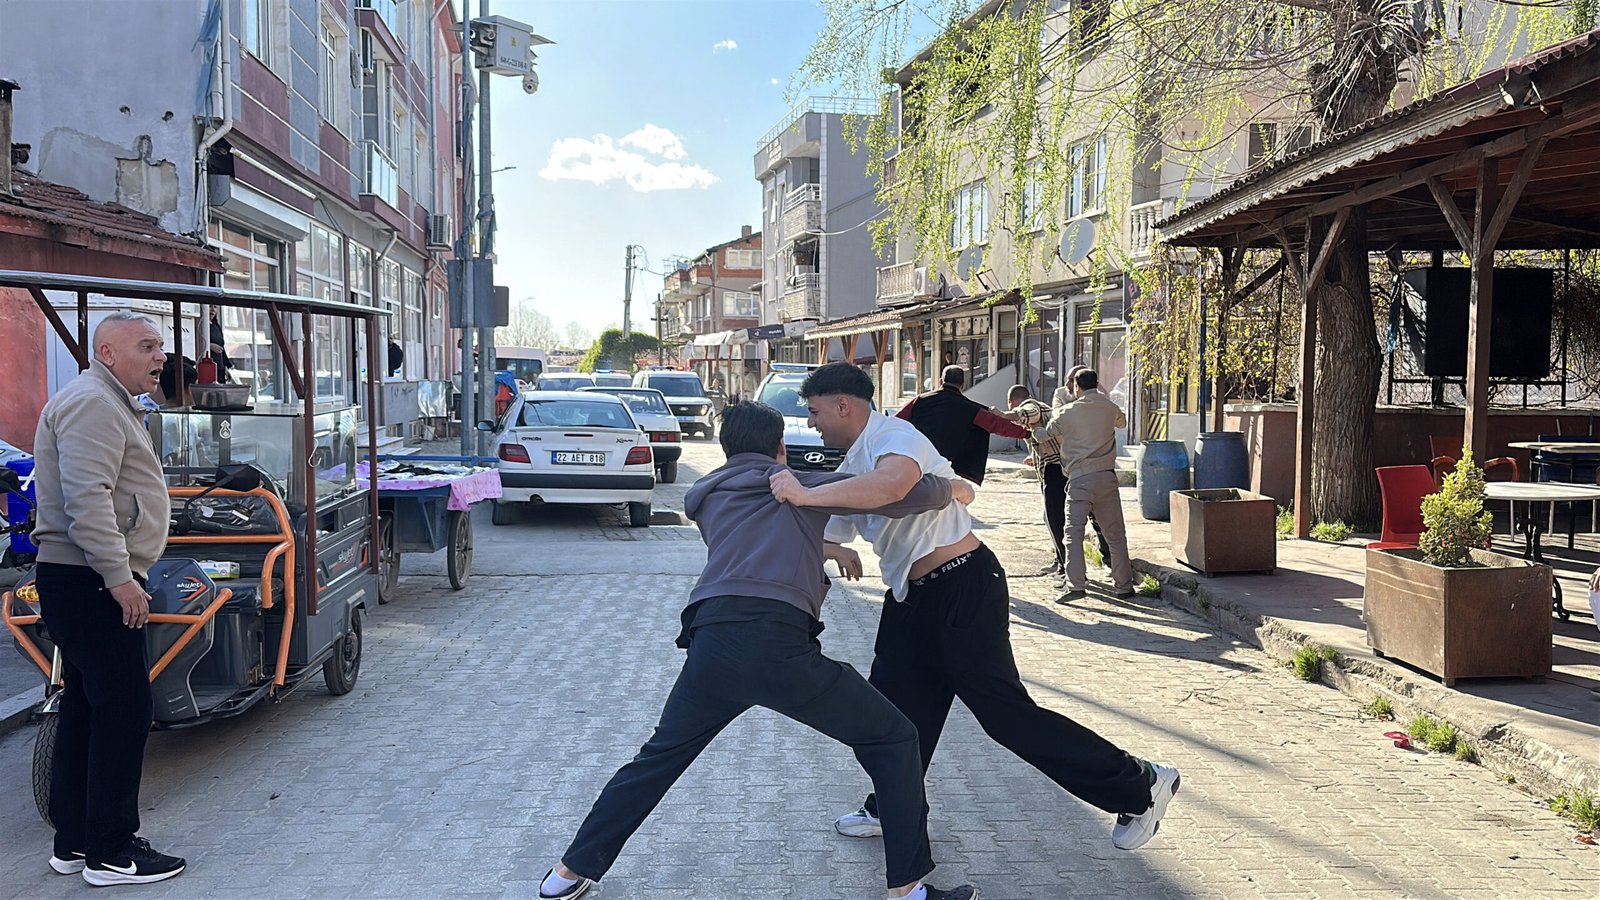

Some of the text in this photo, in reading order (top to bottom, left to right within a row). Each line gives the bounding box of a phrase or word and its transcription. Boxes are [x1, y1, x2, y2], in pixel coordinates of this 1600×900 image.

[557, 453, 604, 463] 22 AET 818
